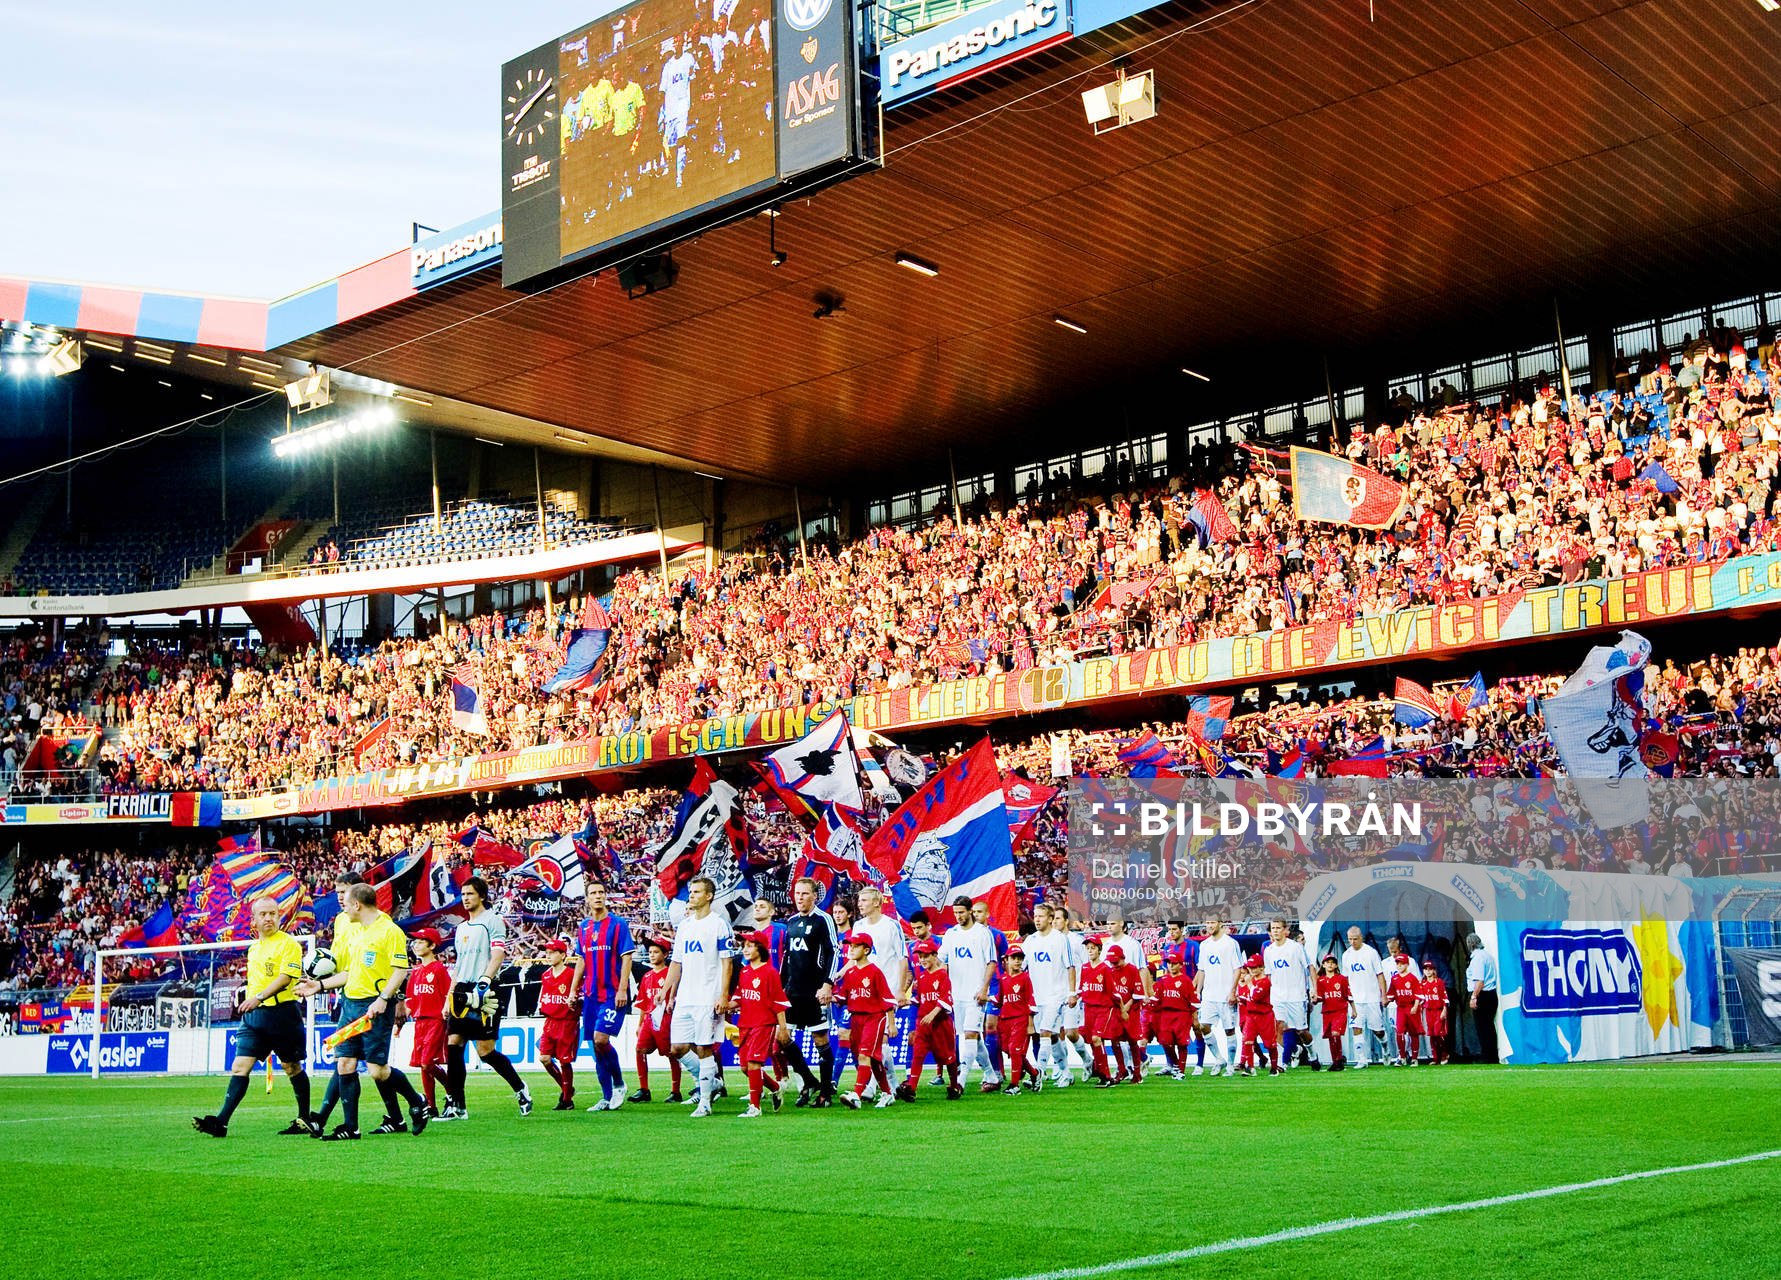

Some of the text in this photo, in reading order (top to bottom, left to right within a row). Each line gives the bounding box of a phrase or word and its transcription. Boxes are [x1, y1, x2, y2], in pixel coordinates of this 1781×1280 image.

[888, 0, 1057, 87] Panasonic
[785, 63, 838, 119] ASAG
[789, 105, 836, 128] Car Sponsor
[511, 160, 551, 186] TISSOT
[1024, 667, 1066, 704] 12
[1084, 643, 1209, 697] BLAU
[600, 728, 656, 767] ROT
[109, 794, 171, 816] FRANCO
[61, 808, 88, 818] Lipton
[1373, 867, 1412, 878] THOMY
[1453, 875, 1485, 911] THOMY
[1307, 885, 1336, 921] THOMY
[684, 940, 704, 954] ICA
[788, 937, 808, 951] ICA
[954, 947, 973, 959] ICA
[1034, 951, 1052, 963] ICA
[1273, 959, 1290, 969] ICA
[1351, 962, 1366, 972] ICA
[418, 984, 435, 994] UBS
[1089, 983, 1104, 992] UBS
[1166, 989, 1181, 998] UBS
[744, 989, 761, 1001] UBS
[25, 1006, 60, 1017] RED BLUE
[604, 1008, 617, 1023] 32
[21, 1024, 41, 1033] PARTY
